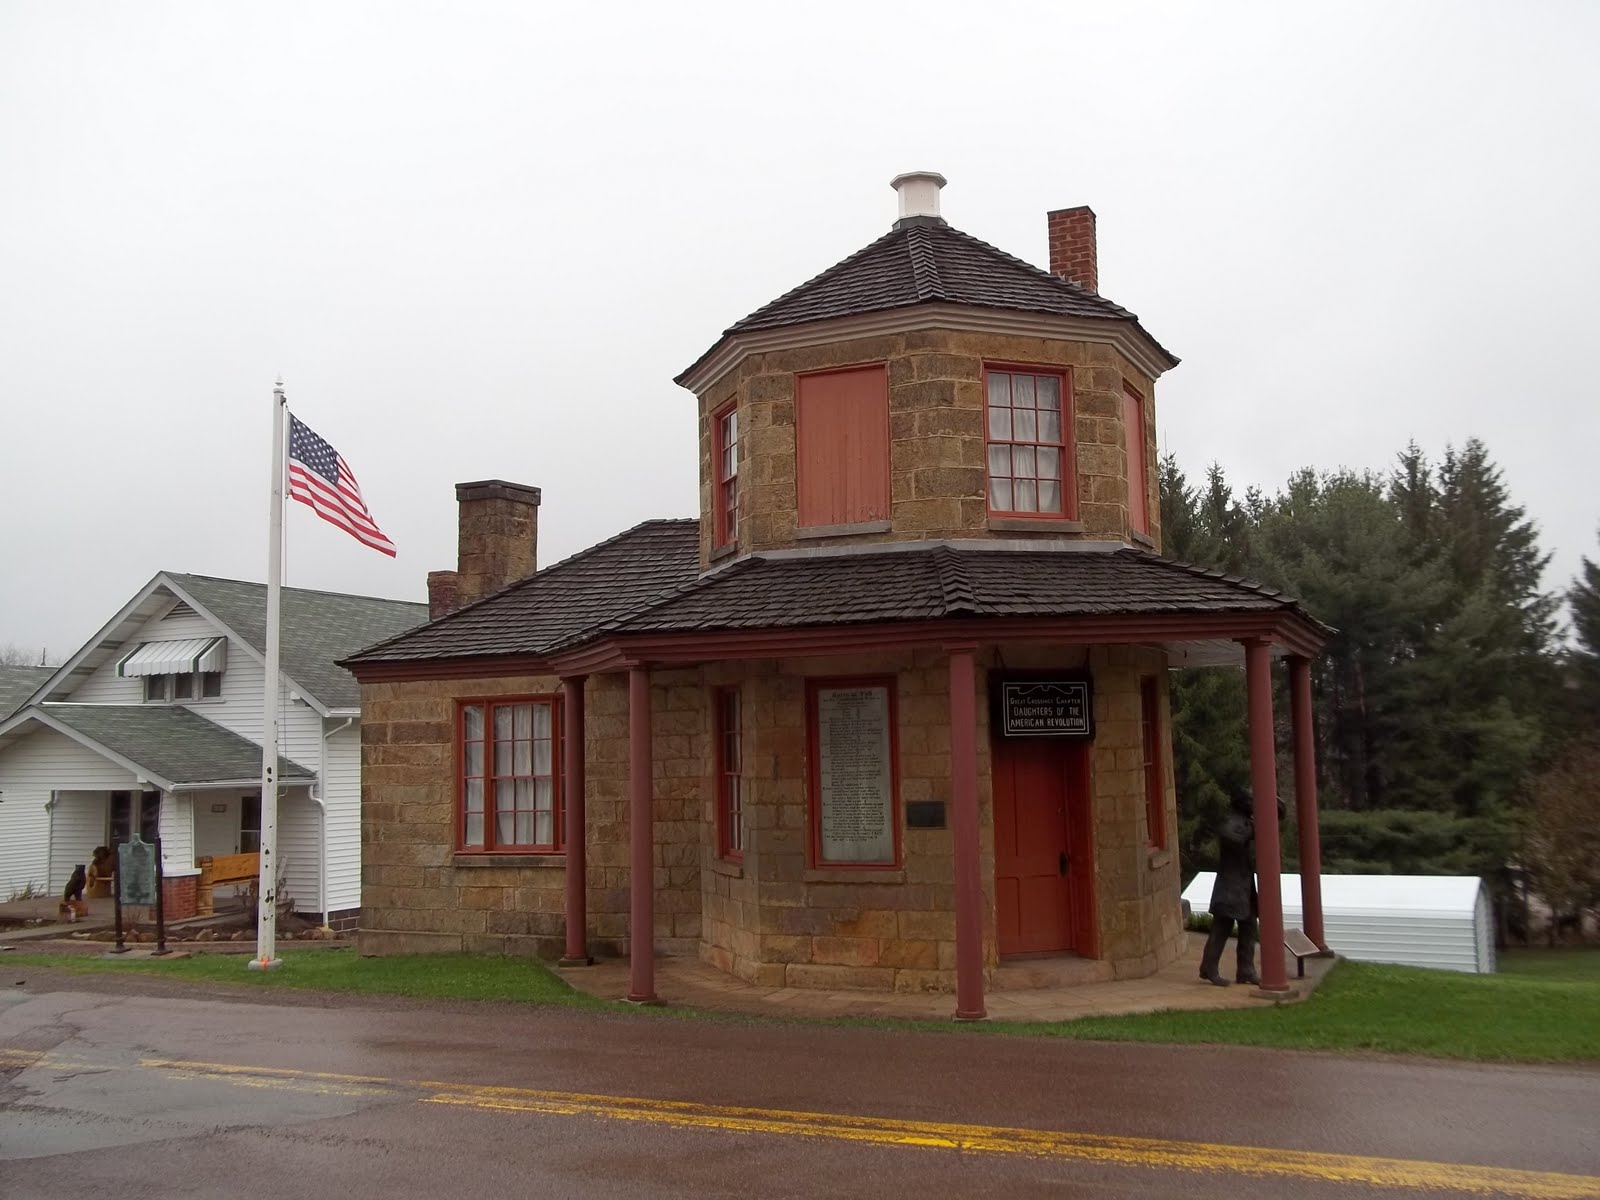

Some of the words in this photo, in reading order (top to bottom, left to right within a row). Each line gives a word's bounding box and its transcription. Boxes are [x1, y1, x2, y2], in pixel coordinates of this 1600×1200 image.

[1013, 707, 1053, 716] DAUGHTERS
[1056, 707, 1065, 716] OF
[1069, 706, 1080, 716] THE
[1010, 719, 1045, 728] AMERICAN
[1047, 718, 1084, 727] REVOLUTION
